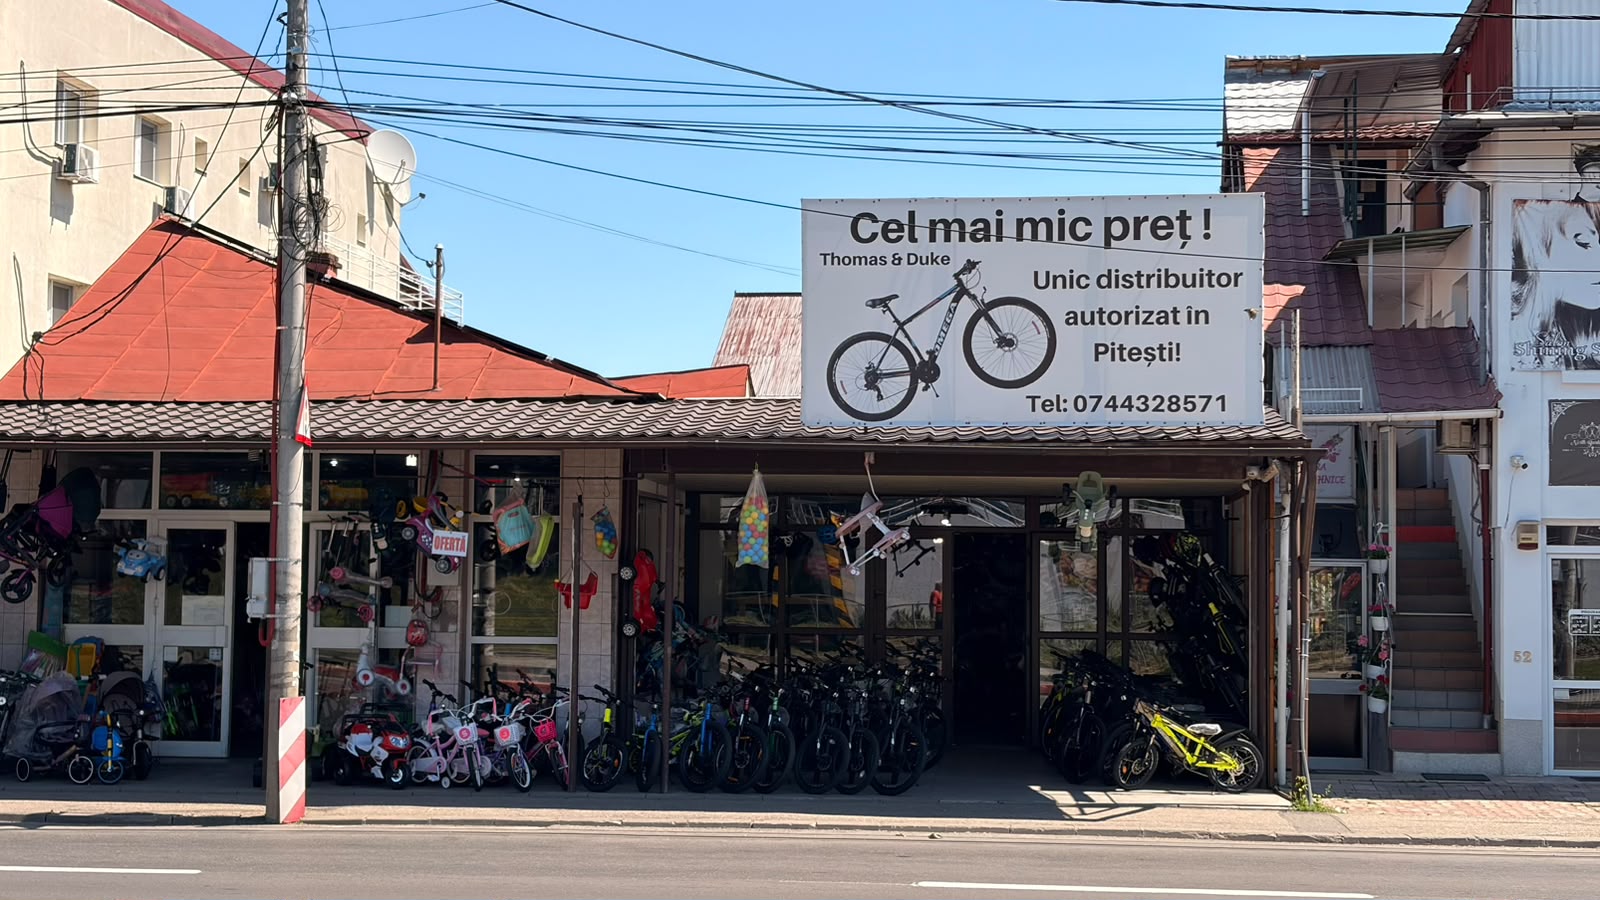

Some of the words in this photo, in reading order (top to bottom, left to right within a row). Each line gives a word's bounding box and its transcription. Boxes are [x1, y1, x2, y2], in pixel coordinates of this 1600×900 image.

[850, 210, 919, 244] Cel
[928, 209, 1004, 243] mai
[1016, 208, 1093, 242] mic
[1103, 209, 1192, 250] preț
[820, 252, 888, 266] Thomas
[891, 252, 903, 266] &
[907, 252, 951, 266] Duke
[1033, 269, 1091, 290] Unic
[1096, 267, 1244, 290] distribuitor
[1064, 304, 1181, 326] autorizat
[1186, 304, 1210, 325] în
[1094, 341, 1181, 368] Pitești!
[1513, 341, 1587, 361] Shining
[1025, 394, 1068, 413] Tel:
[1073, 394, 1226, 413] 0744328571
[434, 535, 466, 553] OFERTĂ
[1513, 650, 1532, 663] 52
